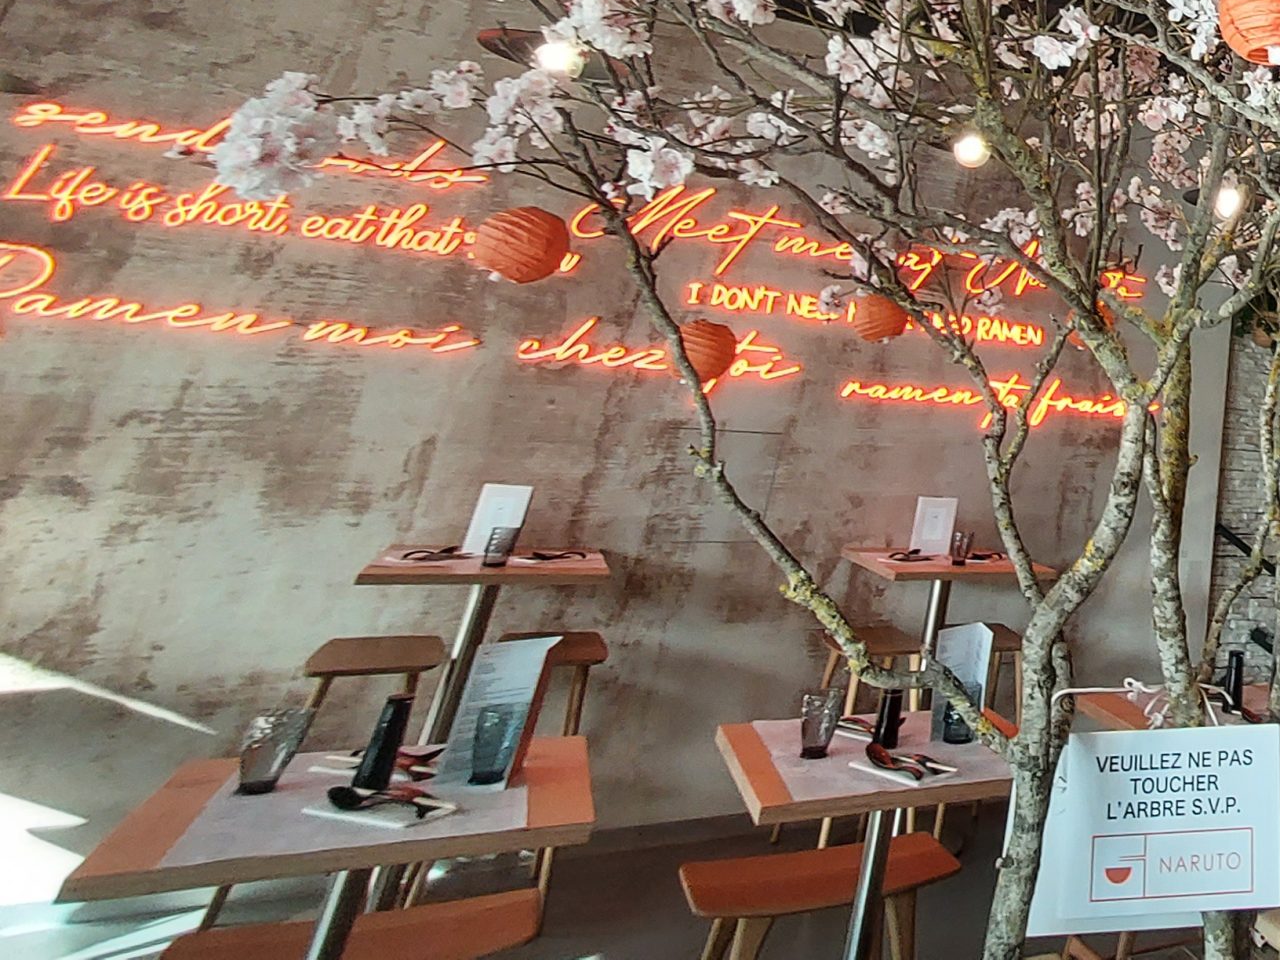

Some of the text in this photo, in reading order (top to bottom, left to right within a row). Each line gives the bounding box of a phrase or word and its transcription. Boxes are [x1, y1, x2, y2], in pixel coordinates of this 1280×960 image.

[3, 144, 118, 221] Life
[120, 182, 166, 221] is
[301, 204, 374, 243] eat
[375, 203, 465, 255] that
[571, 184, 804, 276] Meet
[774, 233, 854, 260] me
[687, 283, 704, 305] I
[711, 285, 782, 315] DON'T
[786, 292, 841, 321] NE
[976, 316, 1044, 346] RAMEN
[303, 321, 481, 353] moi
[517, 315, 669, 371] chez
[841, 378, 984, 406] ramen
[1030, 379, 1160, 428] frais
[1096, 749, 1254, 774] VEUILLEZ NE PAS
[1130, 774, 1220, 796] TOUCHER
[1106, 796, 1242, 820] L'ARBRE S.V.P.
[1158, 851, 1242, 874] NARUTO
